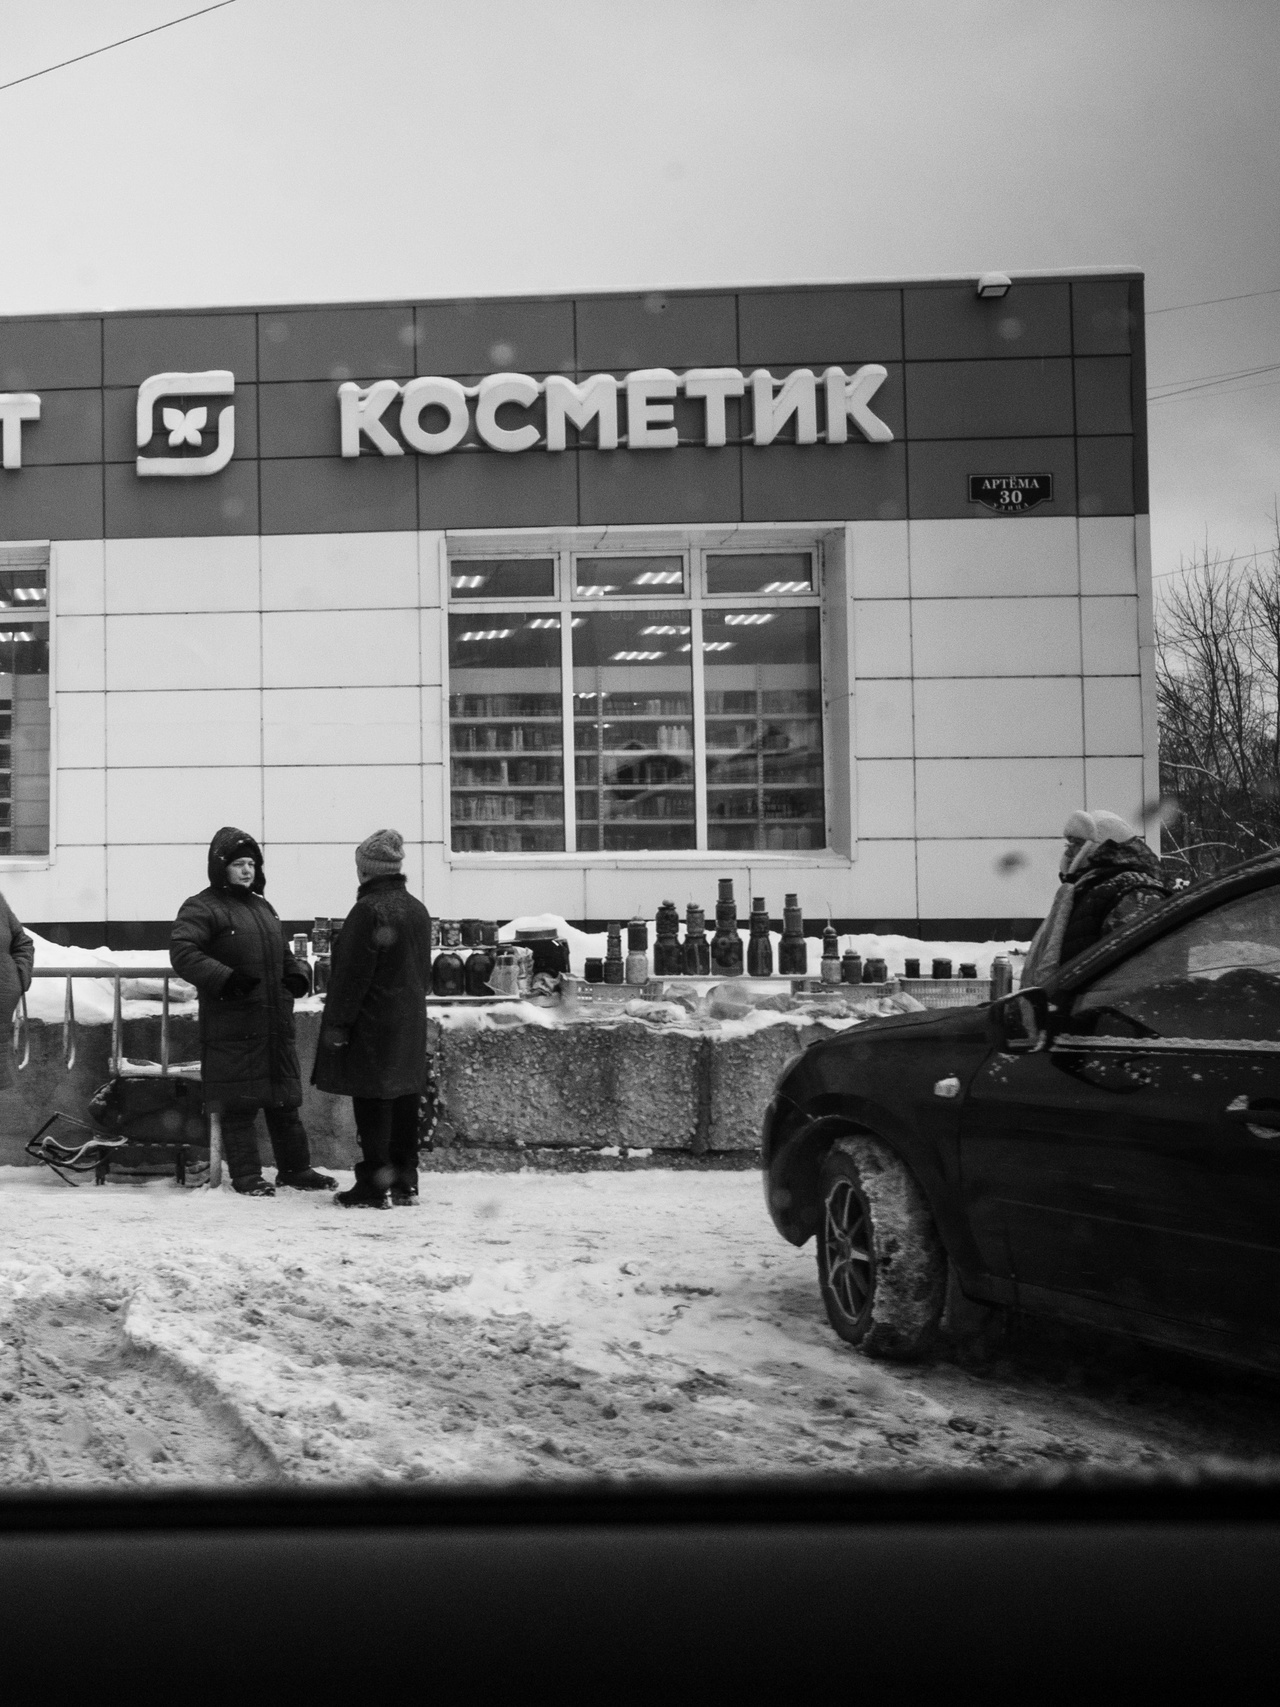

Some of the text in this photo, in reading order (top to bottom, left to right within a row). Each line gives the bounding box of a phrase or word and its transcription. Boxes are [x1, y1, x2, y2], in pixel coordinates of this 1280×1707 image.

[337, 362, 895, 458] КОСМЕТИК
[982, 476, 1040, 489] АРТЁМА
[1000, 490, 1023, 504] 30
